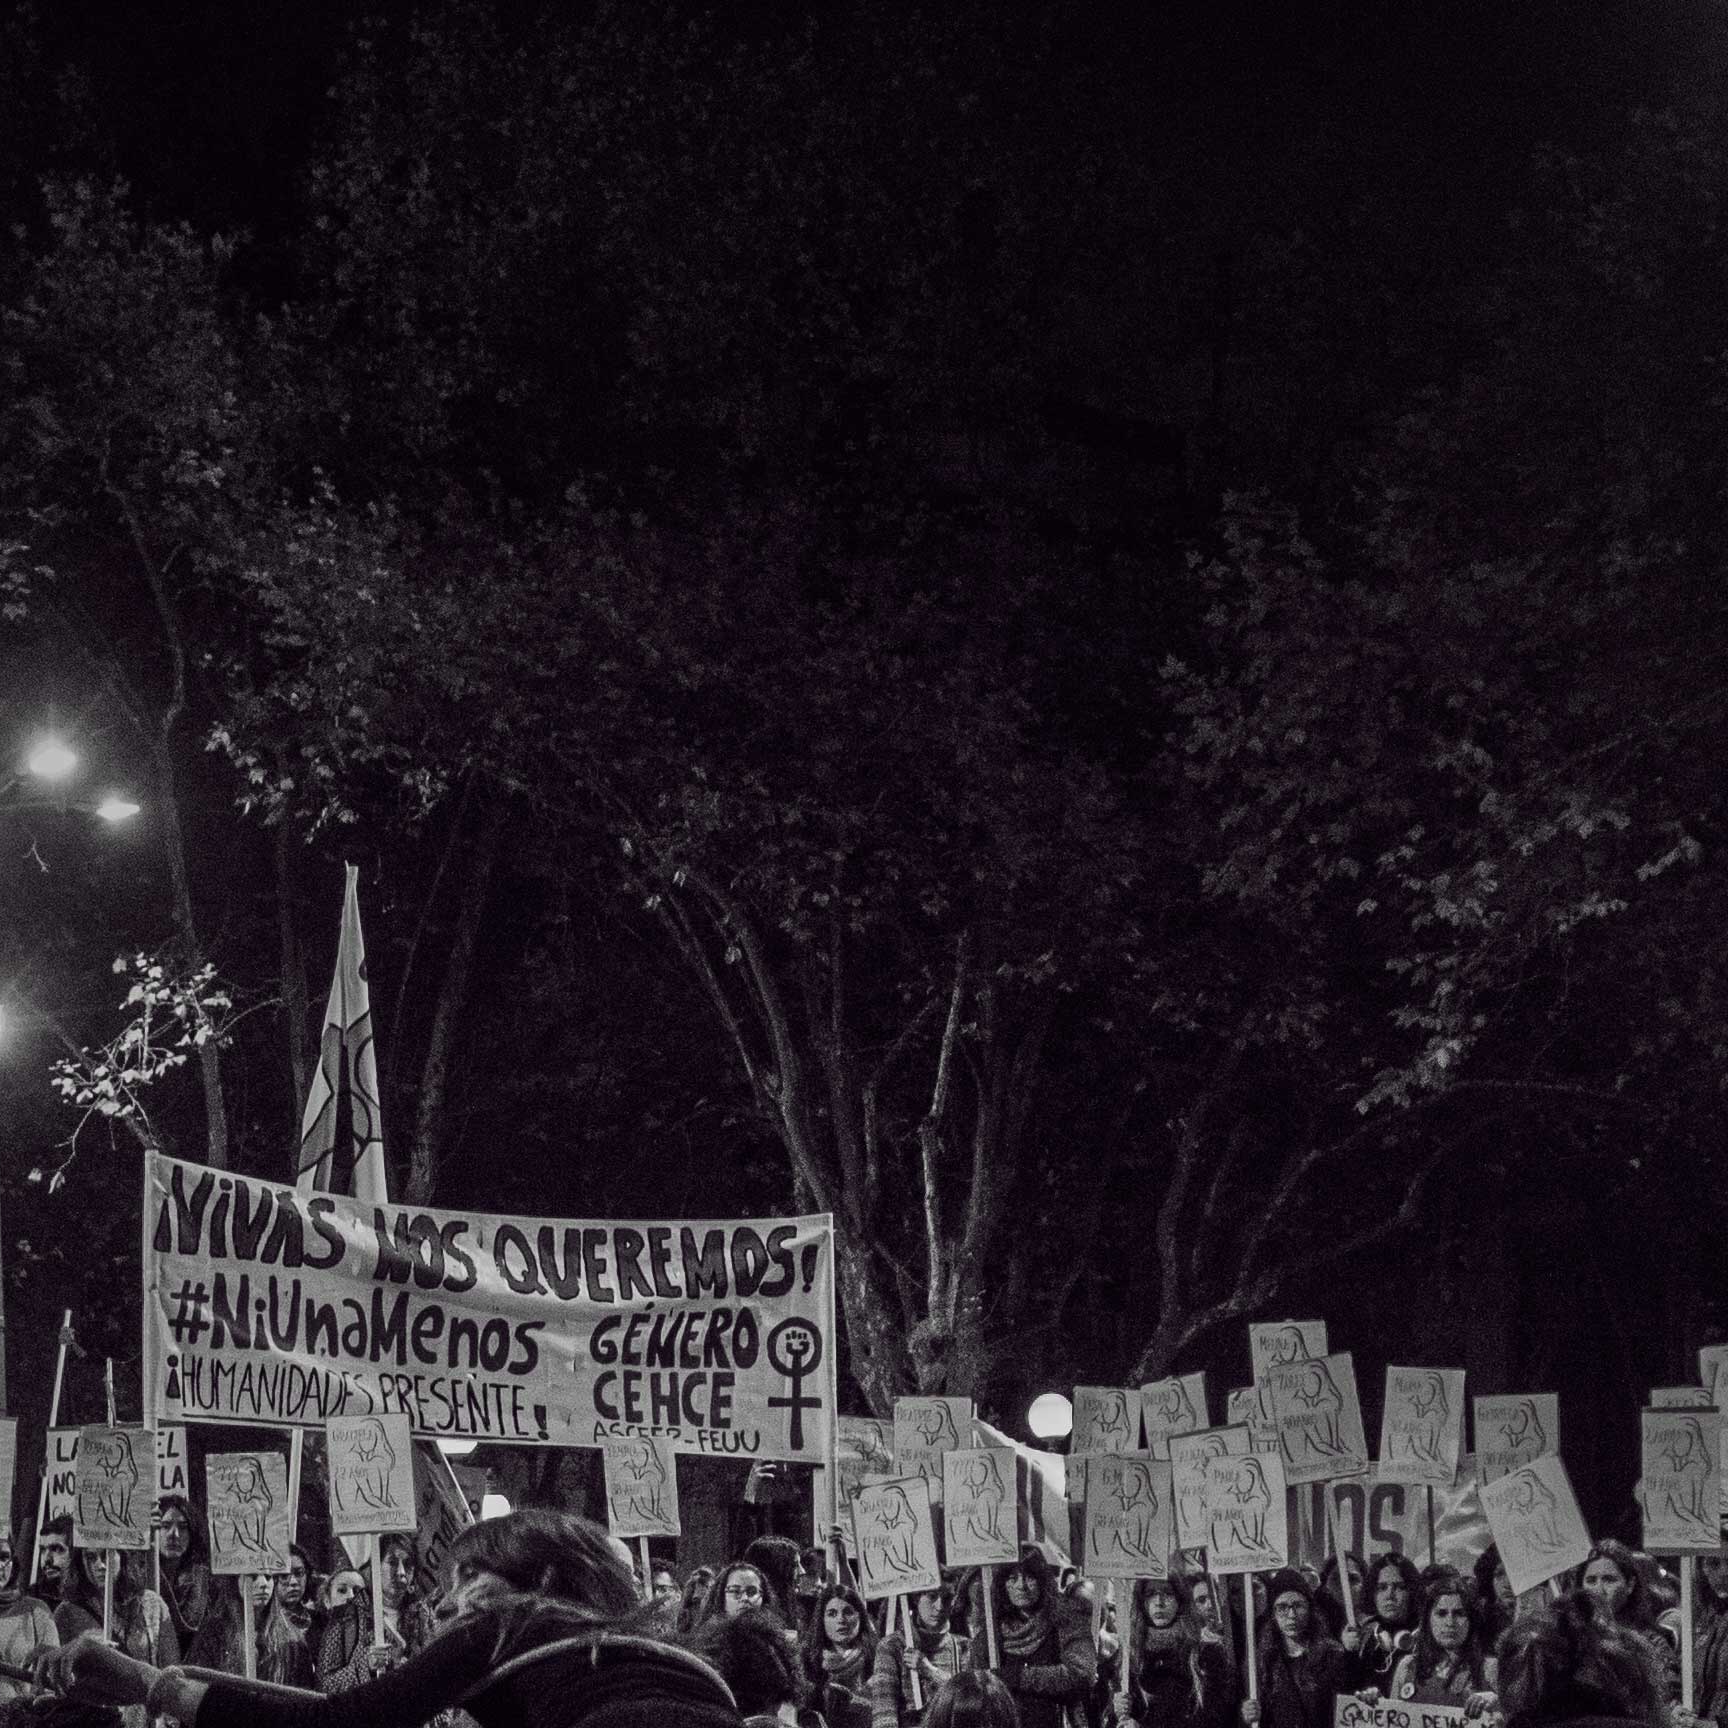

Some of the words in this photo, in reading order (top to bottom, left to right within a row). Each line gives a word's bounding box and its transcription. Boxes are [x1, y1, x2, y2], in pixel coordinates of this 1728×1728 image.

[373, 1207, 478, 1292] NOS
[494, 1224, 819, 1303] QUEREMOS!
[593, 1370, 735, 1428] CEHCE
[160, 1465, 185, 1490] LA
